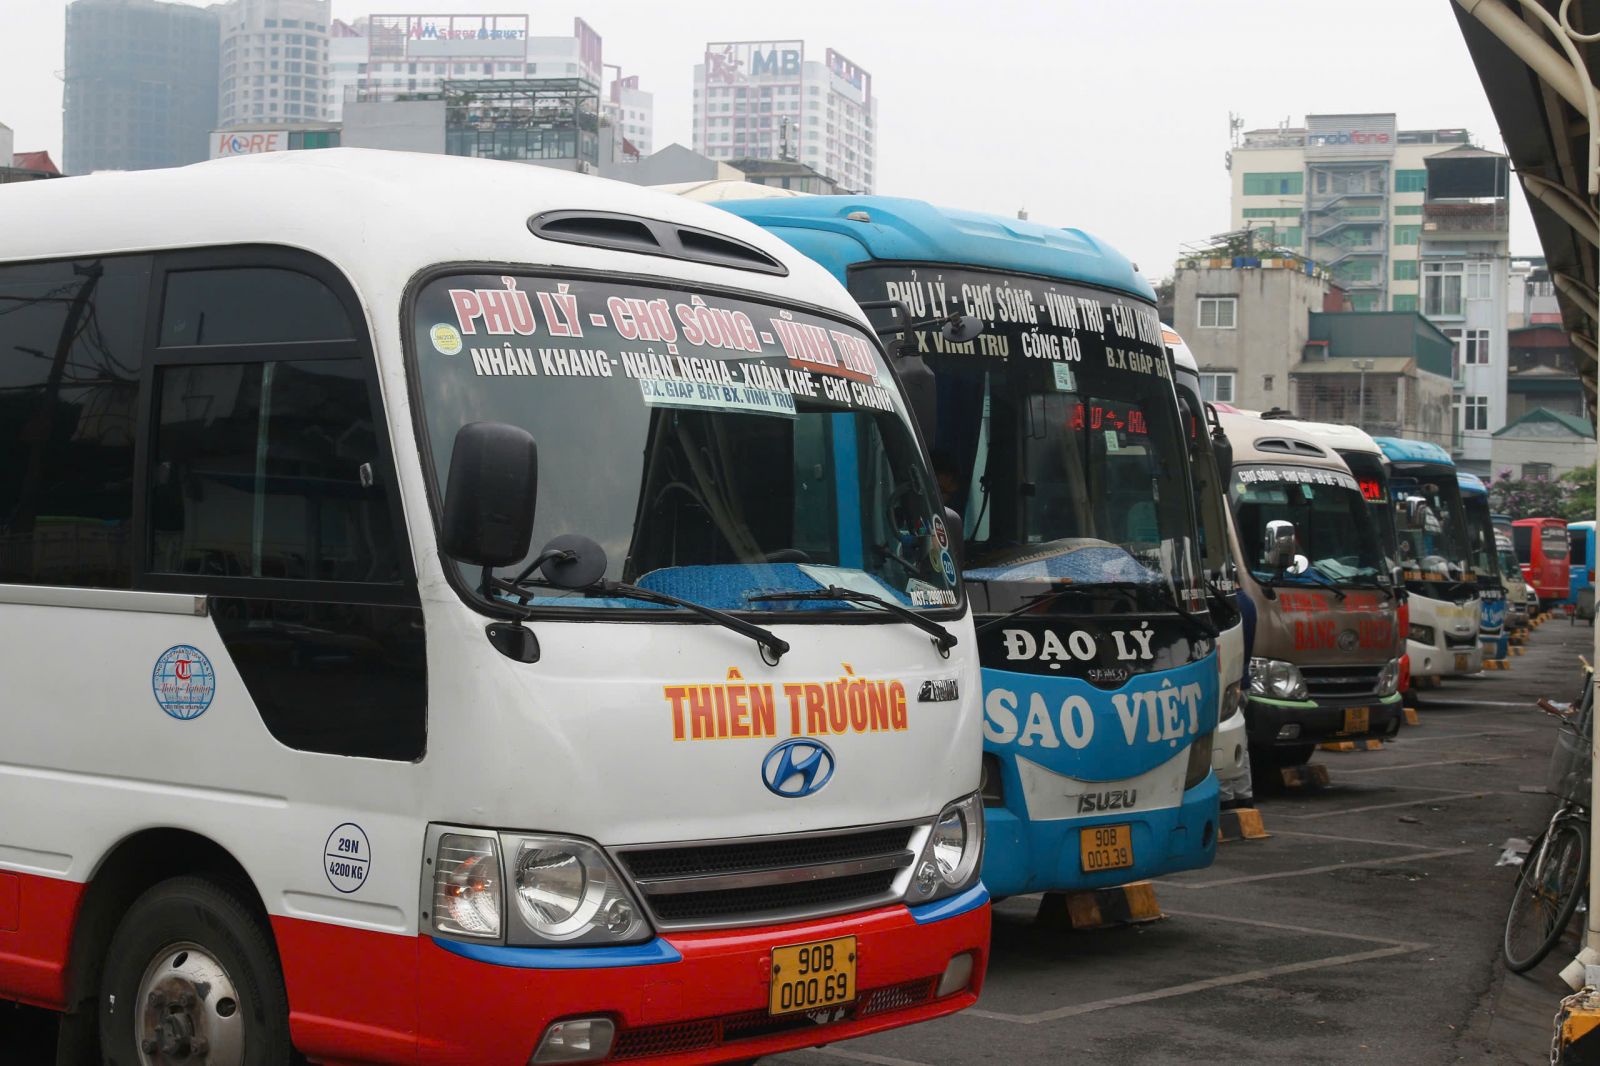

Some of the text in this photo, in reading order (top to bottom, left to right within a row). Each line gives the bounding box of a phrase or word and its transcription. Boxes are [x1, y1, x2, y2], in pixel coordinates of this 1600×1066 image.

[752, 49, 800, 75] MB
[886, 270, 926, 318] PHỦ
[927, 274, 949, 318] LÝ
[961, 283, 995, 329] CHỢ
[1044, 287, 1080, 329] VĨNH
[1077, 297, 1104, 340] TRỤ
[448, 276, 537, 336] PHỦ
[536, 283, 583, 338] LÝ
[607, 296, 679, 354] CHỢ
[675, 294, 762, 353] SÔNG
[769, 309, 839, 368] VĨNH
[829, 329, 881, 387] TRỤ
[977, 333, 1009, 362] TRỤ
[1062, 328, 1081, 362] ĐỎ
[1105, 346, 1128, 370] B.X
[1128, 348, 1153, 375] GIÁP
[470, 342, 538, 376] NHÂN
[739, 360, 788, 392] XUÂN
[821, 375, 852, 407] CHỢ
[1002, 621, 1155, 669] ĐẠO LÝ
[662, 662, 909, 741] THIÊN TRƯỜNG
[983, 678, 1202, 749] SAO VIỆT
[1077, 789, 1137, 813] ISUZU
[338, 838, 359, 853] 29N
[1095, 828, 1117, 847] 90B
[329, 862, 363, 879] 4200 KG
[1087, 847, 1128, 869] 003.39
[799, 944, 834, 974] 90B
[781, 972, 847, 1009] 000.69
